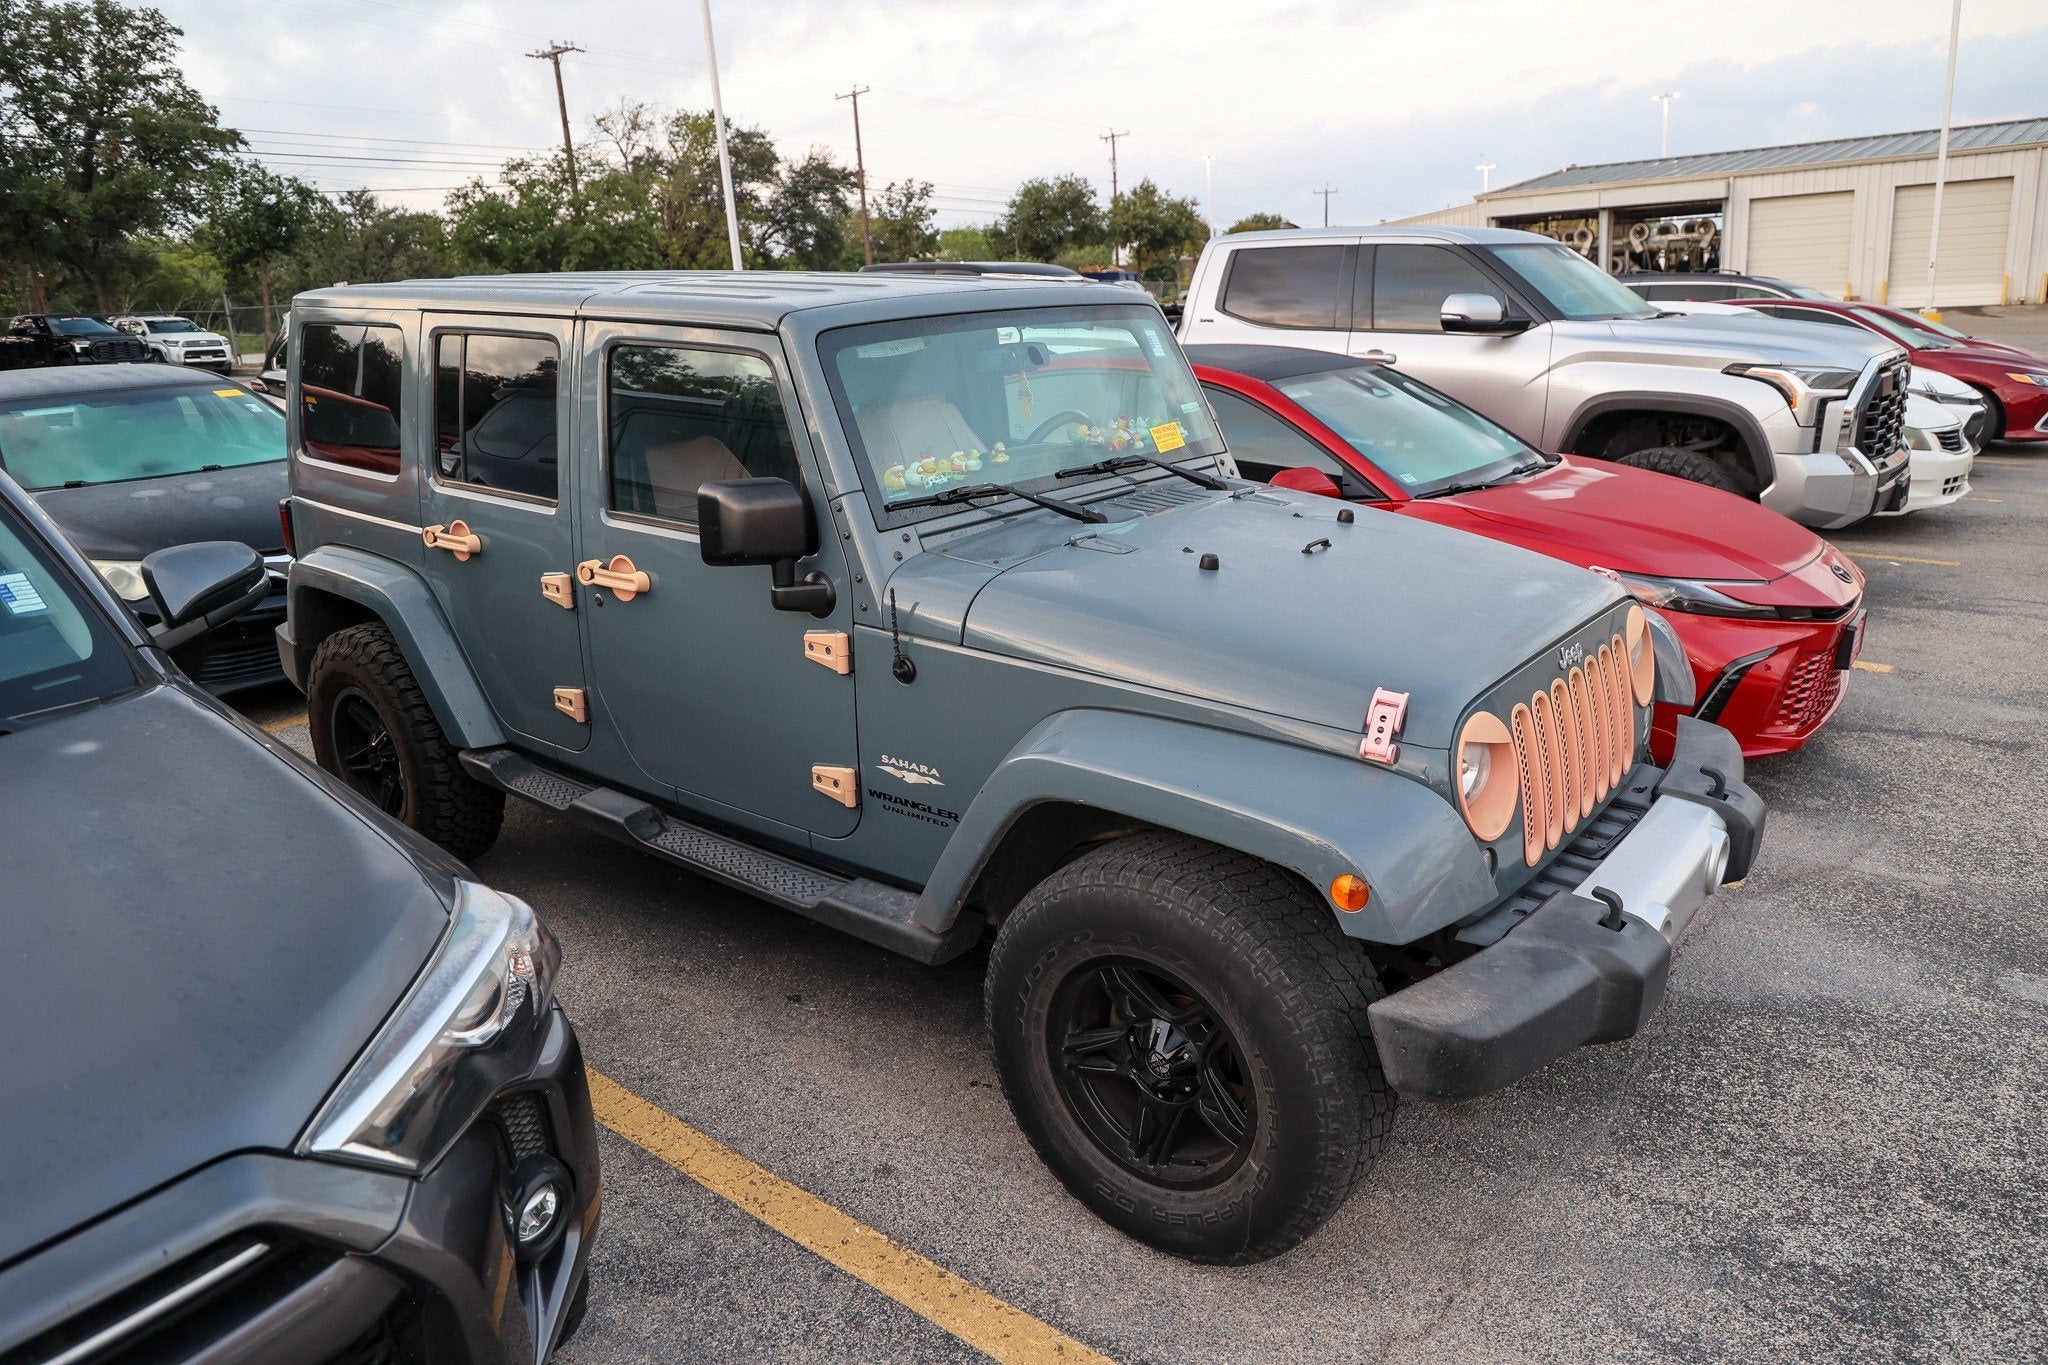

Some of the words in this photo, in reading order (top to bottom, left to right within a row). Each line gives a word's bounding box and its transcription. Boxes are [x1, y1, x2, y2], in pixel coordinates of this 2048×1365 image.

[1558, 642, 1582, 670] Jeep
[881, 754, 940, 778] SAHARA
[868, 788, 960, 823] WRANGLER
[882, 804, 949, 828] UNLIMITED
[1253, 1052, 1279, 1151] TERRA
[1094, 1177, 1139, 1214] G2
[1151, 1164, 1272, 1226] GRAPPLER
